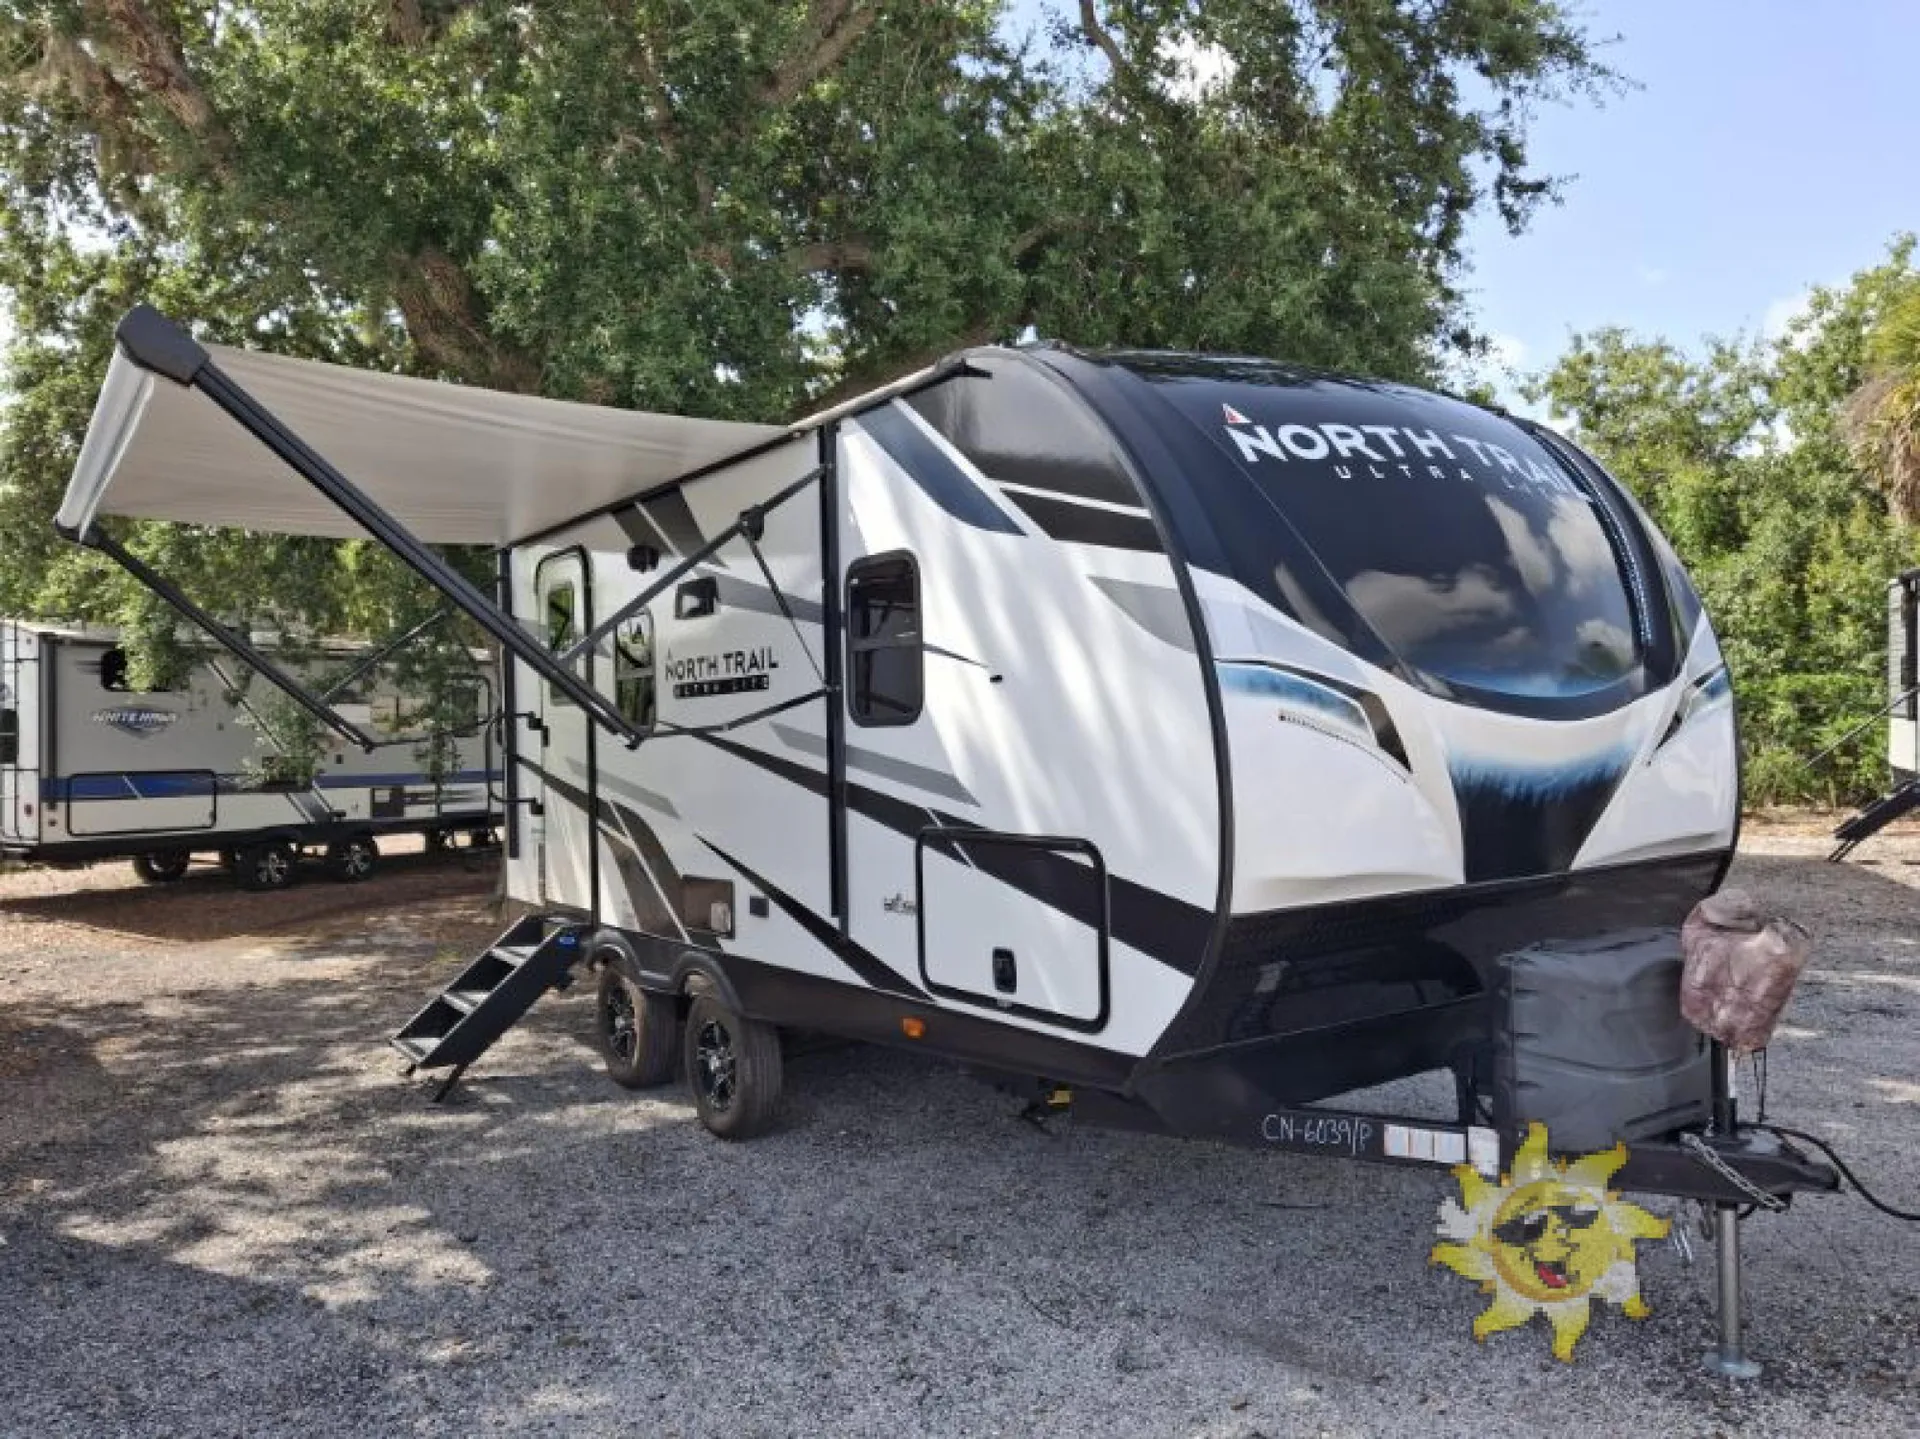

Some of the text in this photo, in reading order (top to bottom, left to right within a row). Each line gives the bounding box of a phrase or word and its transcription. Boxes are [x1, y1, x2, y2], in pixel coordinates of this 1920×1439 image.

[1224, 424, 1457, 463] NORTH
[1334, 464, 1474, 481] ULTRA
[665, 646, 779, 681] NORTH TRAIL
